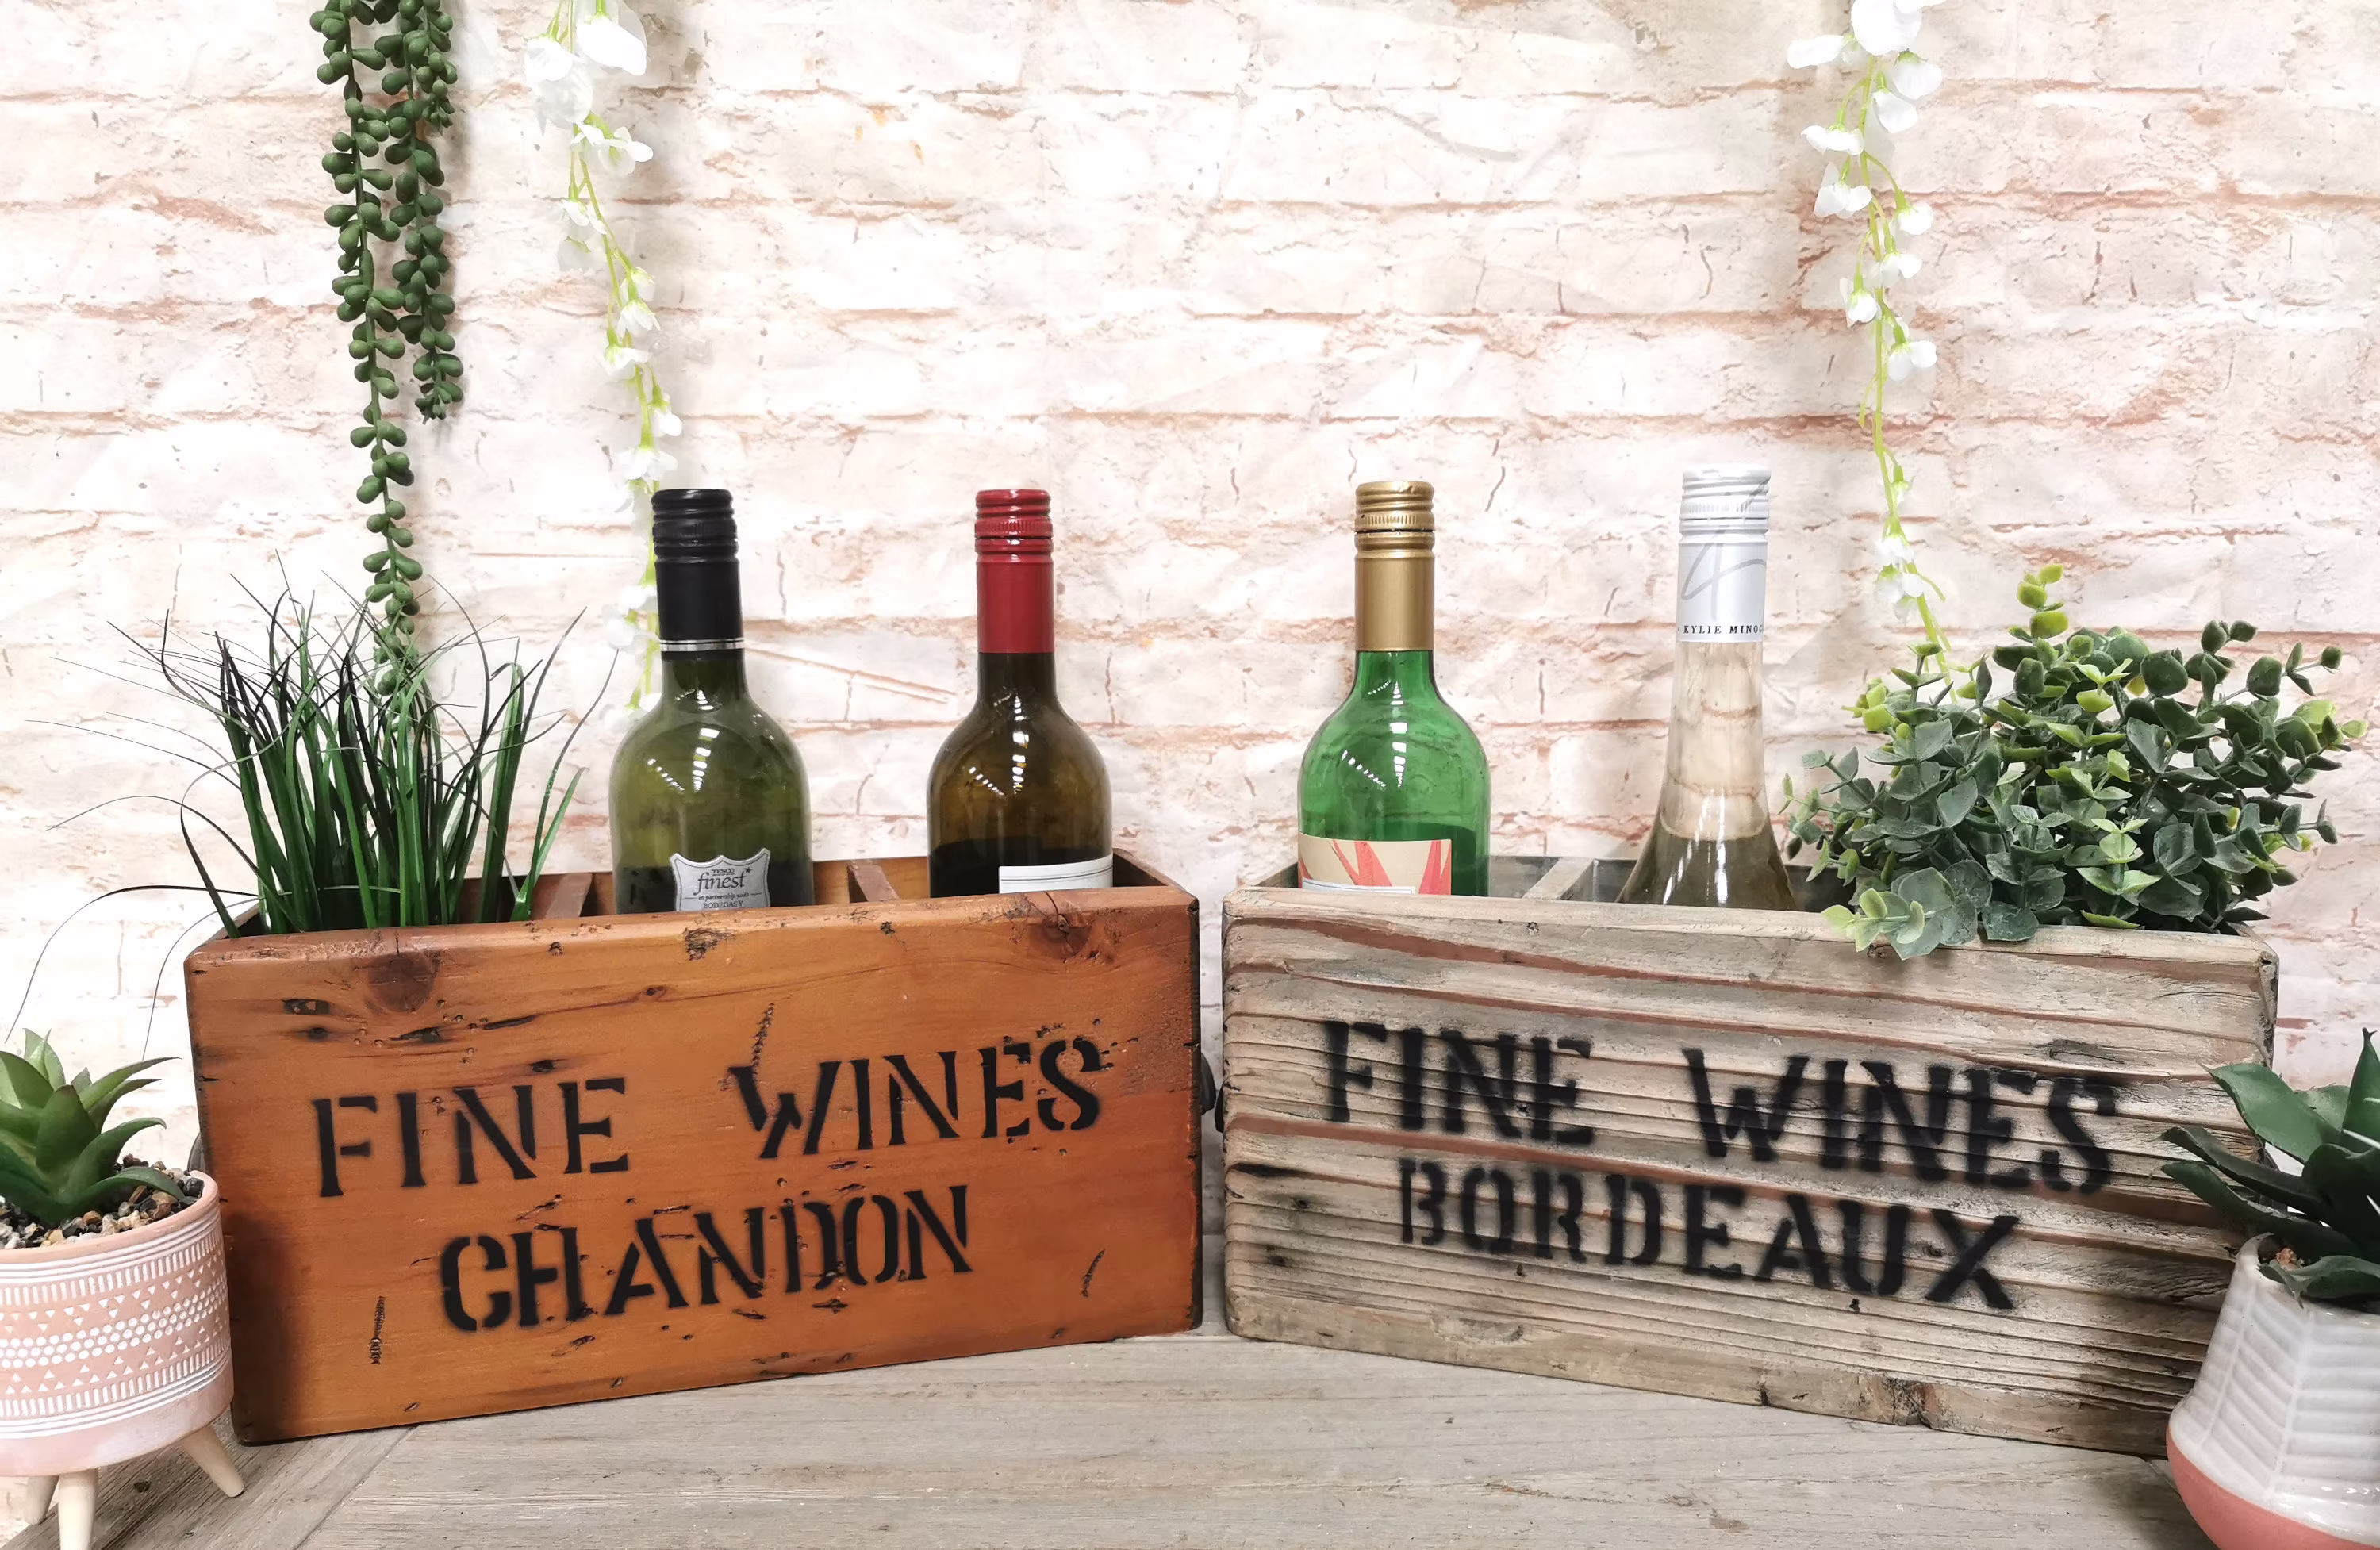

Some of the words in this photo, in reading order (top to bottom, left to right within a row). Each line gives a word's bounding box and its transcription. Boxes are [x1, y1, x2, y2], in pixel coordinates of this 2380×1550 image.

[1683, 625, 1722, 634] KYLIE
[693, 871, 747, 896] finest
[705, 892, 736, 902] partnership
[313, 1077, 628, 1198] FINE
[727, 1039, 1103, 1158] WINES
[1323, 1020, 1595, 1145] FINE
[1681, 1047, 2118, 1195] WINES
[440, 1185, 971, 1331] CHANDON
[1399, 1157, 2019, 1310] BORDEAUX
